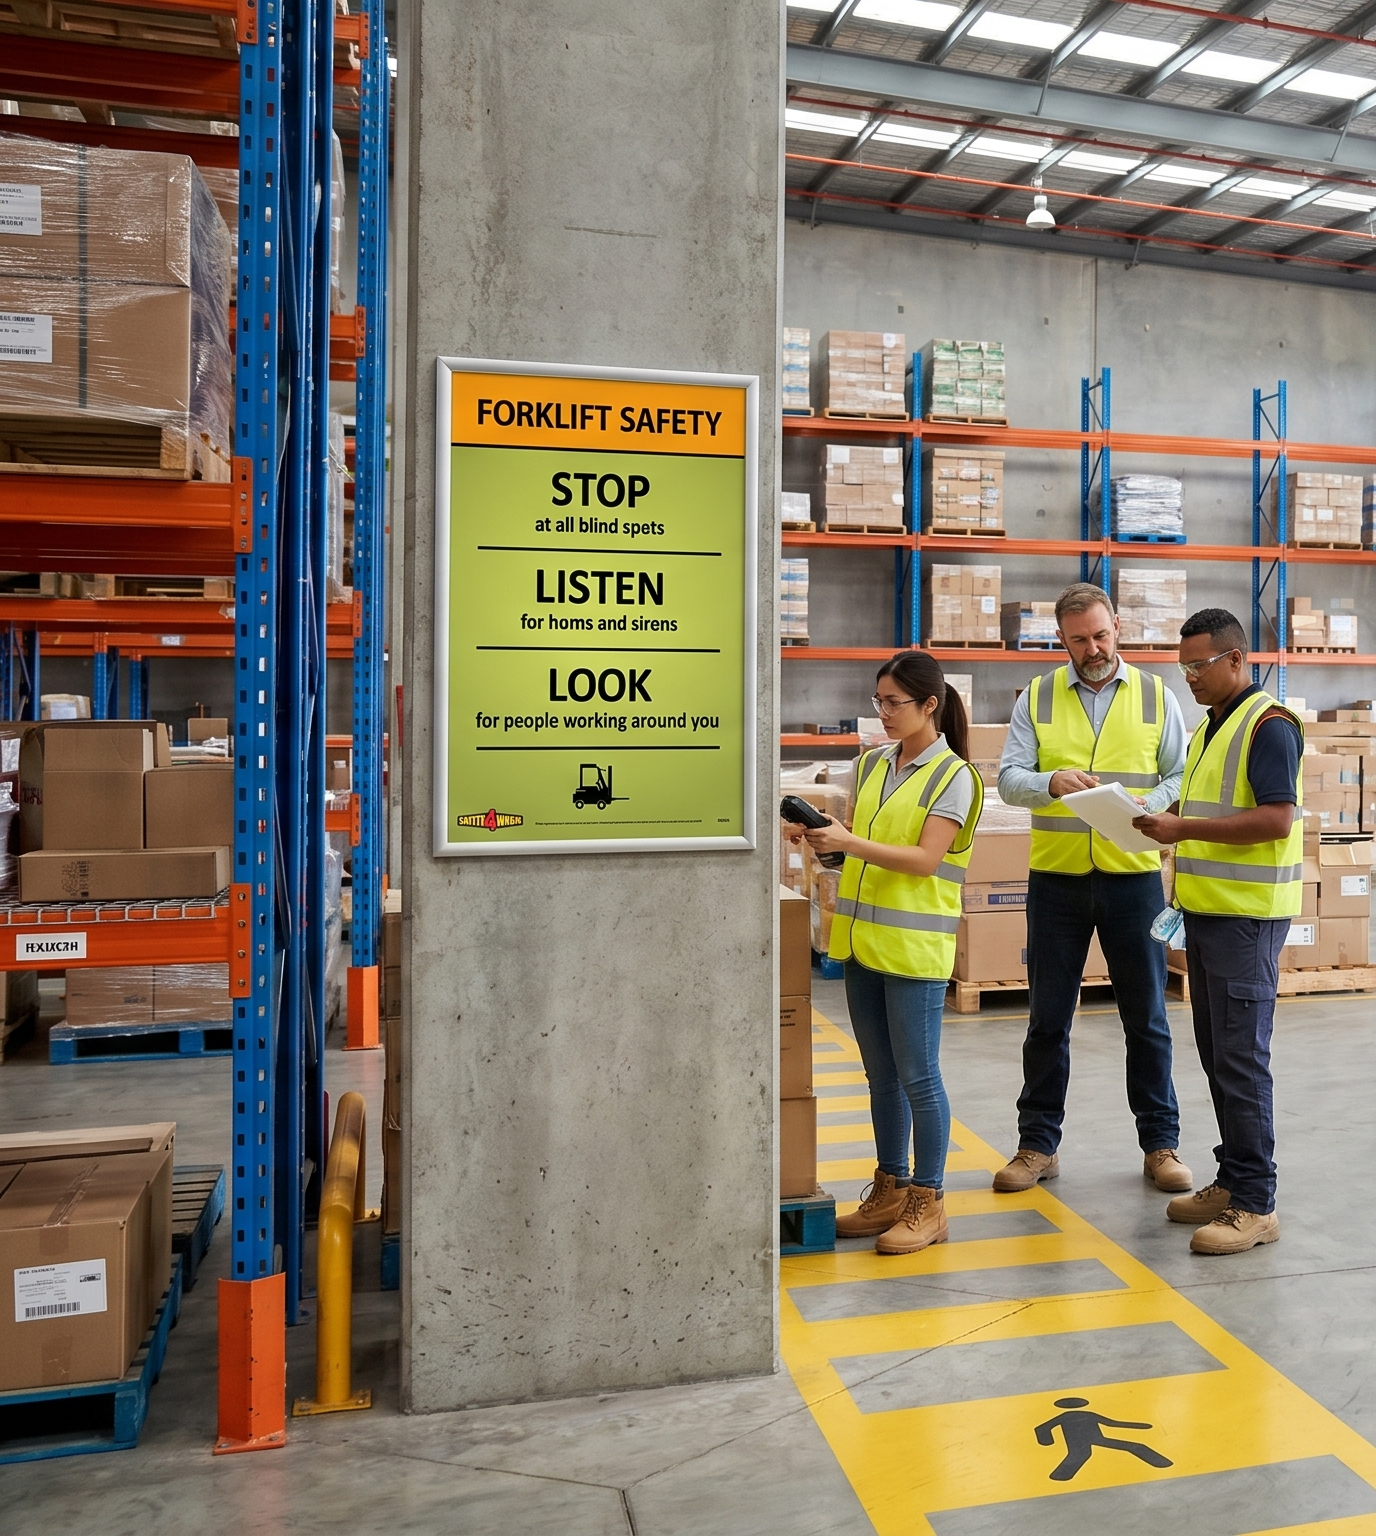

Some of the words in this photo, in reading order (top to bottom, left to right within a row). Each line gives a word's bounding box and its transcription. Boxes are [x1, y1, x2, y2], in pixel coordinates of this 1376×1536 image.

[477, 398, 613, 431] FORKLIFT
[620, 406, 723, 437] SAFETY
[551, 471, 650, 508] STOP
[535, 517, 552, 532] at
[555, 516, 574, 533] all
[579, 516, 619, 534] blind
[622, 520, 665, 539] spets
[536, 569, 664, 606] LISTEN
[520, 613, 545, 630] for
[597, 614, 627, 631] and
[631, 615, 678, 632] sirens
[549, 667, 653, 703] LOOK
[475, 711, 500, 729] for
[504, 711, 559, 733] people
[563, 711, 628, 733] working
[631, 711, 687, 729] around
[690, 716, 719, 732] you
